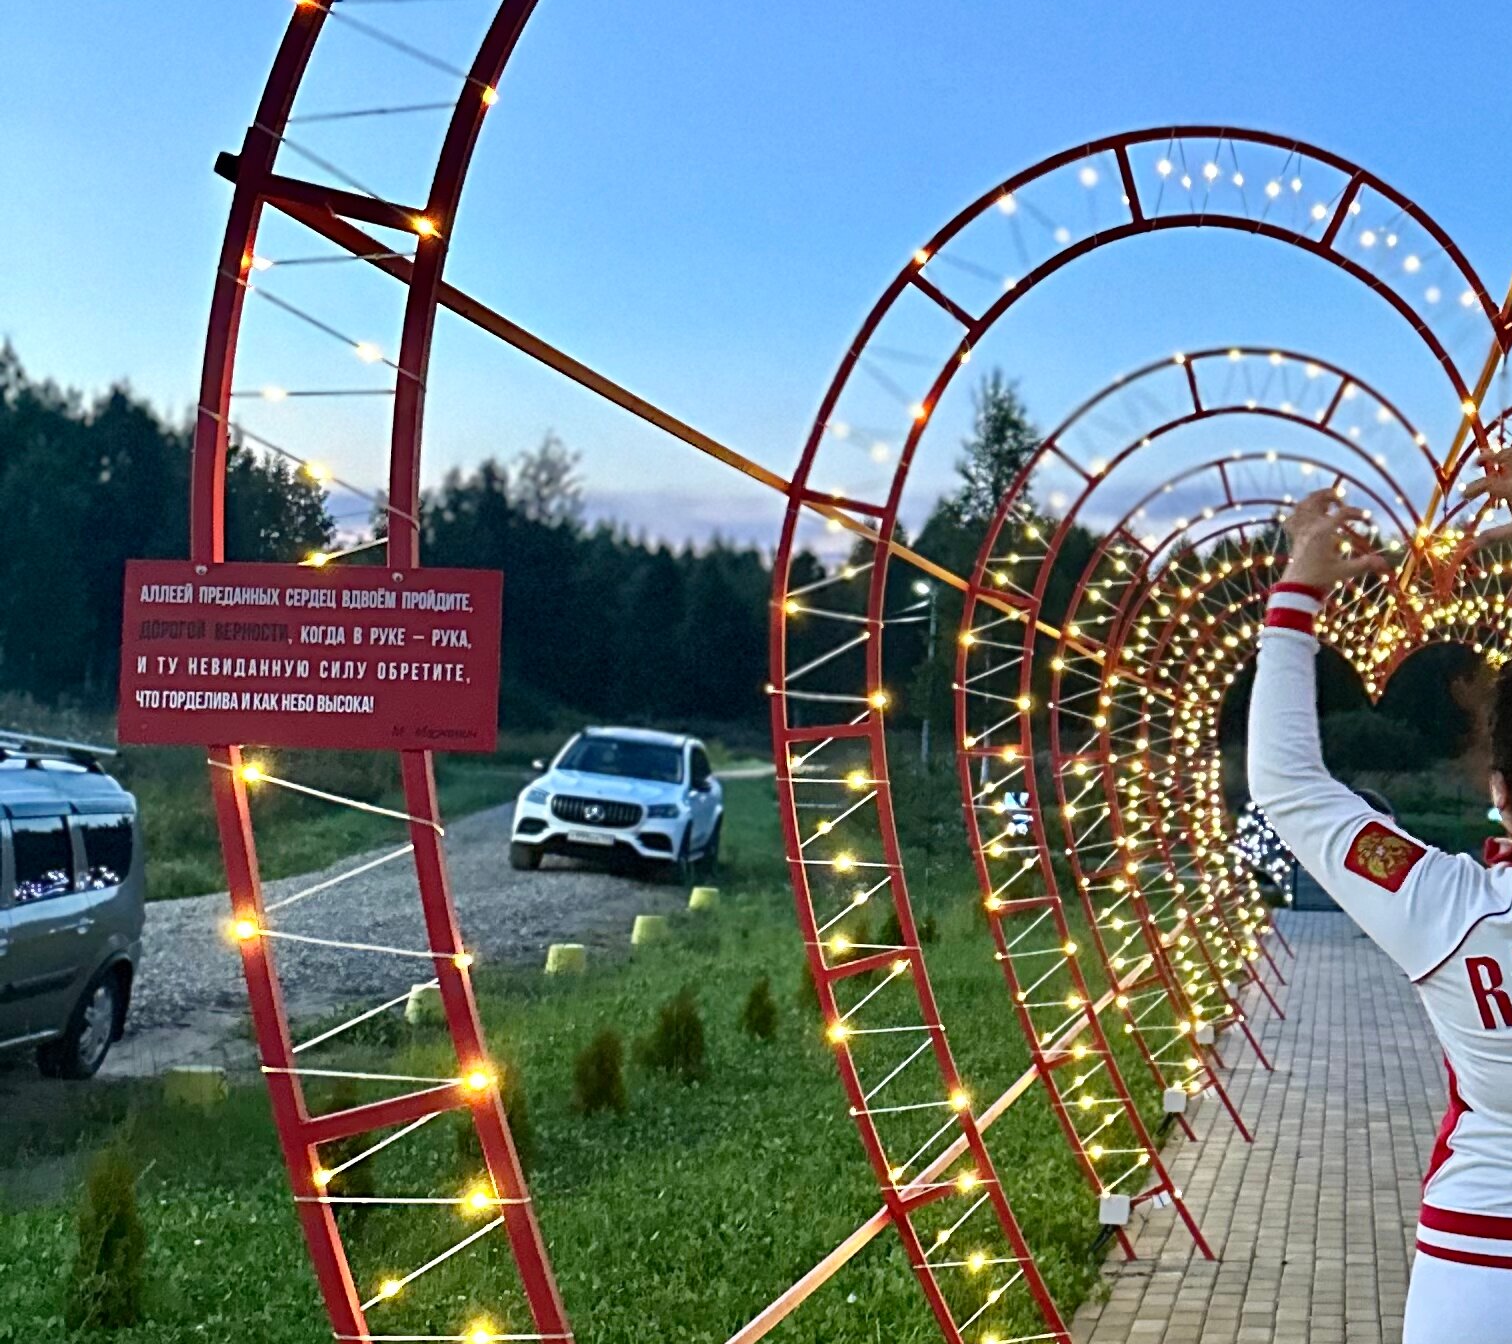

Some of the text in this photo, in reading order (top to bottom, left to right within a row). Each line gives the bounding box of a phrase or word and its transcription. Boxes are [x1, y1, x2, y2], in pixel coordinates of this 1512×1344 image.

[140, 584, 473, 613] АЛЛЕЕЙ ПРЕДАННЫХ СЕРДЕЦ ВДВОЁМ ПРОЙДИТЕ,
[301, 626, 345, 645] КОГДА
[353, 627, 362, 644] В
[370, 628, 405, 646] РУКЕ
[432, 629, 472, 648] РУКА,
[138, 656, 471, 684] И ТУ НЕВИДАННУЮ СИЛУ ОБРЕТИТЕ,
[136, 691, 374, 713] ЧТО ГОРДЕЛИВА И КАК НЕБО ВЫСОКА!
